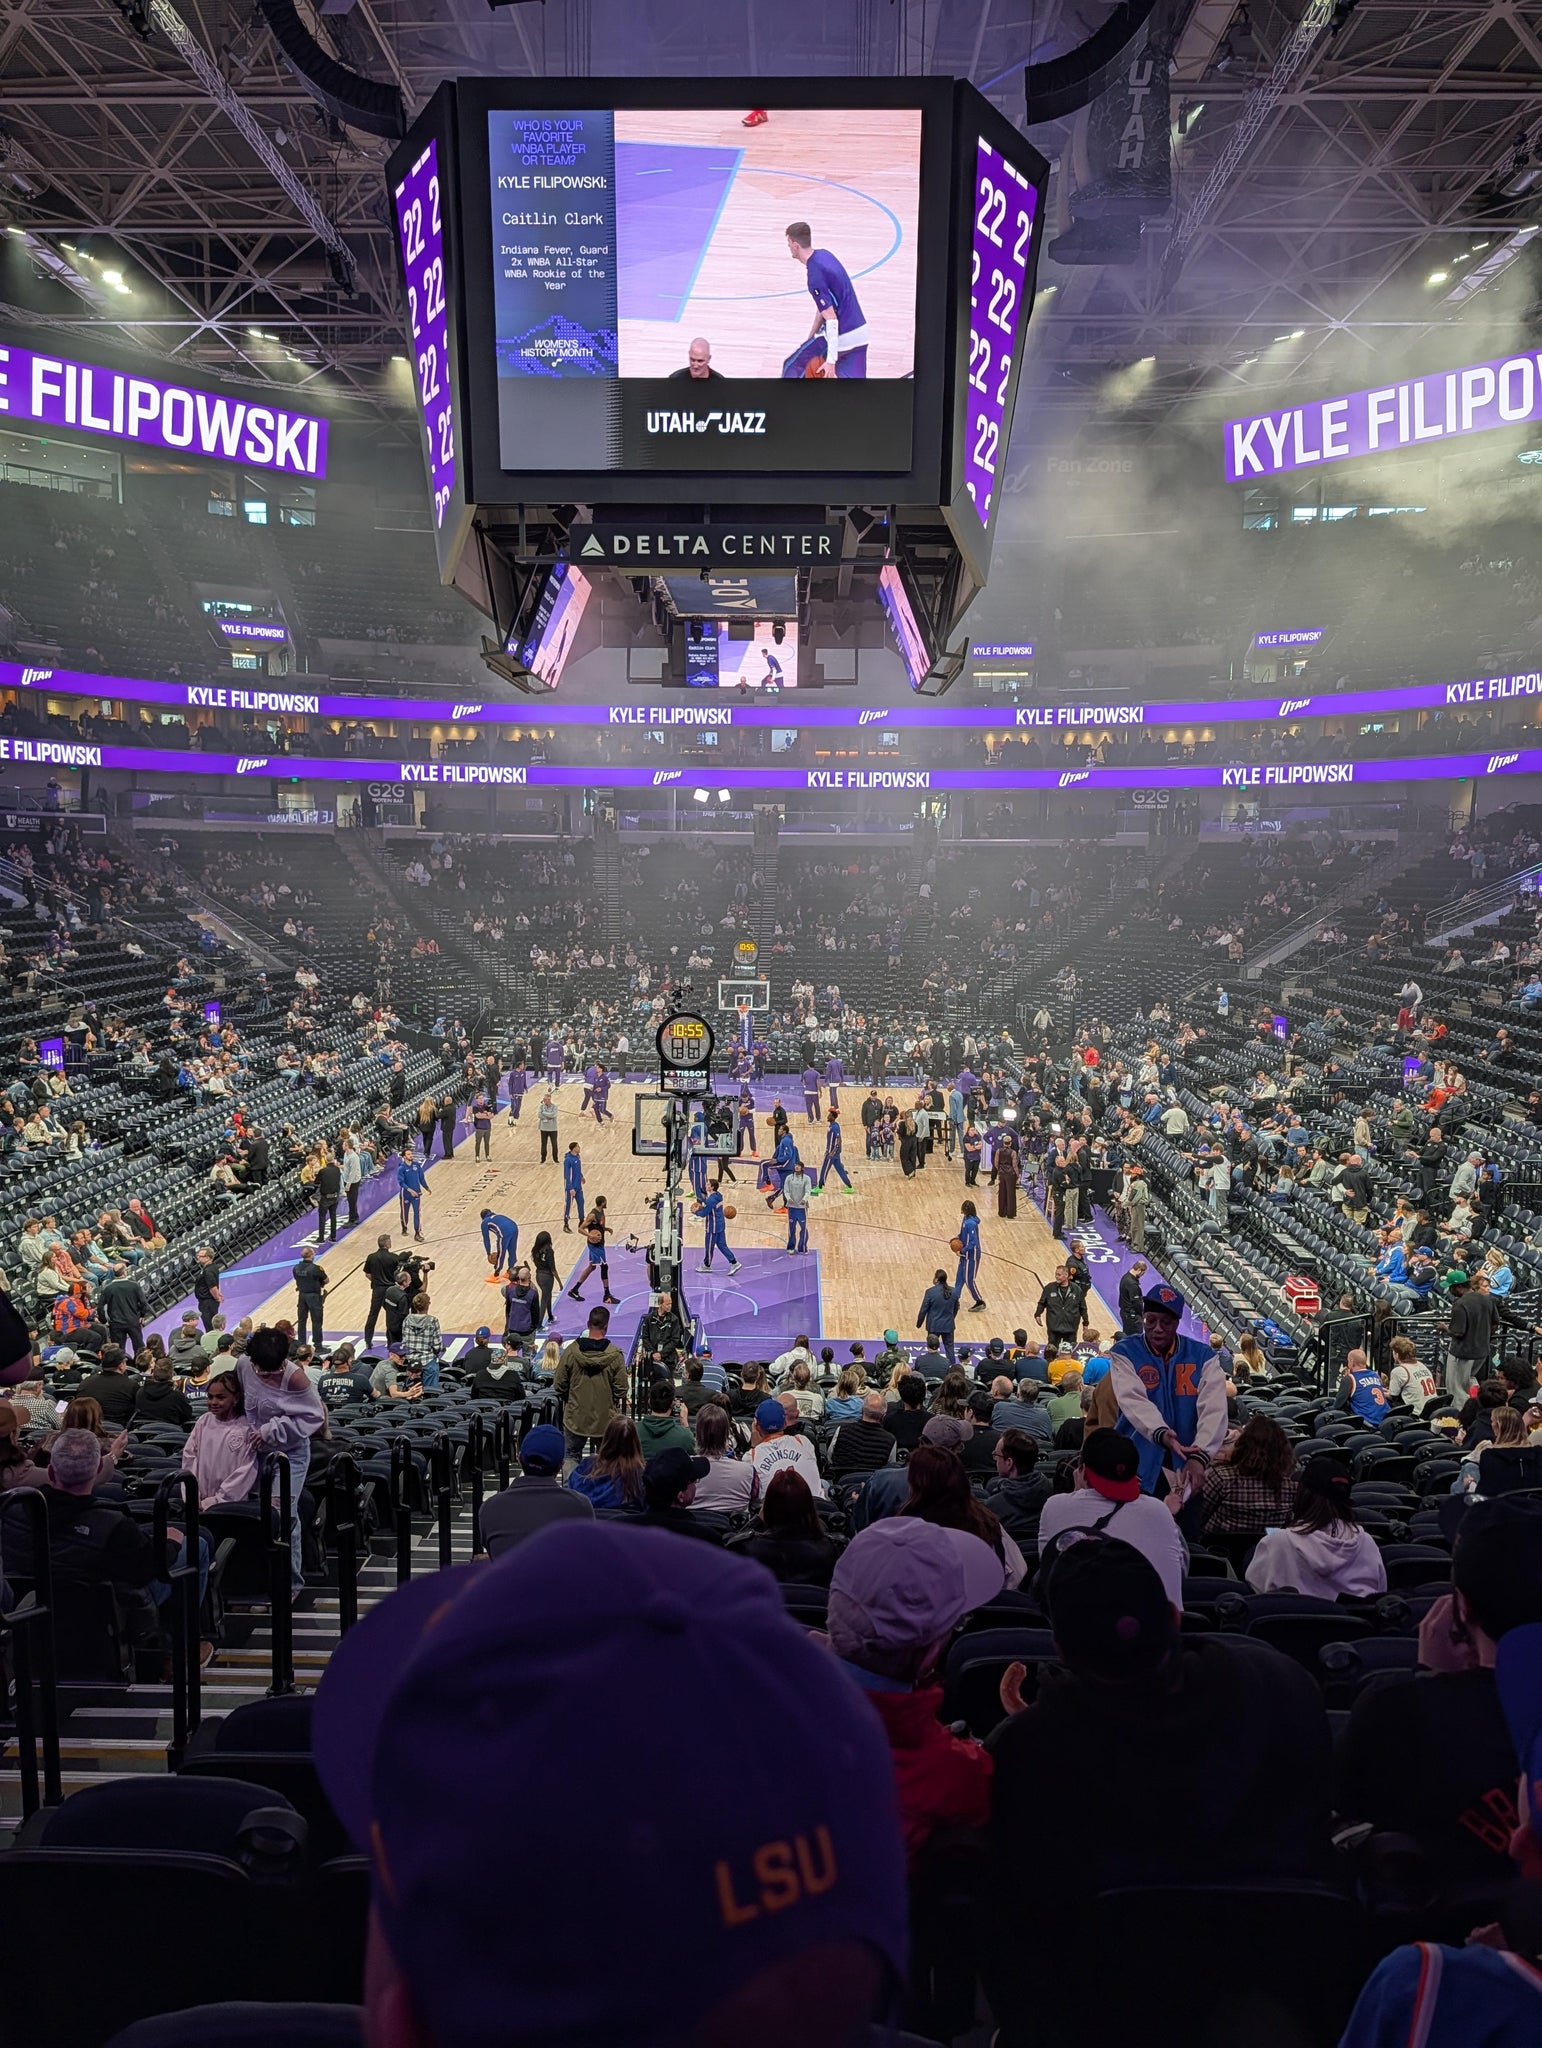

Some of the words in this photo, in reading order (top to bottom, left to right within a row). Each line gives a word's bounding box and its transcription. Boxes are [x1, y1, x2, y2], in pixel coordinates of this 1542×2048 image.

[1118, 60, 1154, 169] UTAH
[512, 120, 540, 131] WHO
[542, 120, 552, 131] IS
[554, 120, 583, 131] YOUR
[523, 132, 573, 142] FAVORITE
[511, 143, 545, 154] WNBA
[546, 143, 586, 154] PLAYER
[521, 155, 538, 166] OR
[540, 155, 576, 166] TEAM?
[498, 176, 530, 189] KYLE
[533, 176, 607, 189] FILIPOWSKI:
[502, 212, 557, 225] Caitlin
[564, 212, 604, 225] Clark
[976, 177, 1003, 248] 22
[1013, 210, 1033, 268] 2
[403, 198, 425, 266] 22
[500, 245, 539, 255] Indiana
[544, 245, 573, 256] Fever,
[579, 245, 609, 255] Guard
[511, 257, 523, 267] 2x
[527, 257, 551, 267] WNBA
[555, 257, 599, 267] All-Star
[504, 269, 528, 279] WNBA
[532, 269, 567, 279] Rookie
[571, 269, 582, 279] of
[588, 269, 606, 279] the
[423, 256, 446, 325] 22
[544, 281, 567, 291] Year
[988, 268, 1016, 334] 22
[534, 339, 579, 349] WOMEN'S
[520, 348, 558, 358] HISTORY
[559, 348, 594, 358] MONTH
[419, 343, 440, 407] 22
[31, 356, 319, 474] FILIPOWSKI
[646, 412, 695, 433] UTAH
[718, 412, 766, 433] JAZZ
[1233, 398, 1350, 477] KYLE
[1368, 354, 1542, 450] FILIPO
[973, 413, 999, 475] 22
[1047, 457, 1082, 473] Fan
[1086, 457, 1133, 473] Zone
[613, 535, 710, 555] DELTA
[722, 535, 832, 555] CENTER
[221, 624, 241, 635] KYLE
[242, 626, 284, 639] FILIPOWSKI
[1258, 633, 1277, 645] KYLE
[973, 647, 991, 656] KYLE
[992, 646, 1032, 656] FILIPOWSKI
[21, 668, 53, 685] UTAH
[188, 686, 227, 707] KYLE
[231, 690, 319, 714] FILIPOWSKI
[1446, 681, 1484, 704] KYLE
[452, 705, 482, 719] UTAH
[1016, 708, 1053, 725] KYLE
[1057, 706, 1144, 725] FILIPOWSKI
[1279, 698, 1311, 716] UTAH
[609, 707, 645, 724] KYLE
[650, 707, 732, 725] FILIPOWSKI
[858, 709, 889, 725] UTAH
[14, 740, 102, 767] FILIPOWSKI
[236, 758, 268, 774] UTAH
[1486, 753, 1519, 773] UTAH
[401, 764, 438, 782] KYLE
[443, 765, 527, 784] FILIPOWSKI
[652, 770, 682, 785] UTAH
[807, 771, 843, 788] KYLE
[847, 771, 930, 788] FILIPOWSKI
[1058, 771, 1090, 787] UTAH
[1222, 768, 1260, 785] KYLE
[1265, 764, 1353, 784] FILIPOWSKI
[367, 782, 405, 798] G2G
[1132, 789, 1170, 804] G2G
[18, 817, 40, 825] HEALTH
[673, 1024, 703, 1037] 10:55
[676, 1070, 708, 1078] TISSOT
[469, 1174, 498, 1193] DELTA
[1175, 1363, 1198, 1396] K
[1420, 1377, 1436, 1397] 10
[1371, 1387, 1385, 1406] 3
[760, 1449, 802, 1472] BRUNSON
[715, 1824, 837, 1928] LSU
